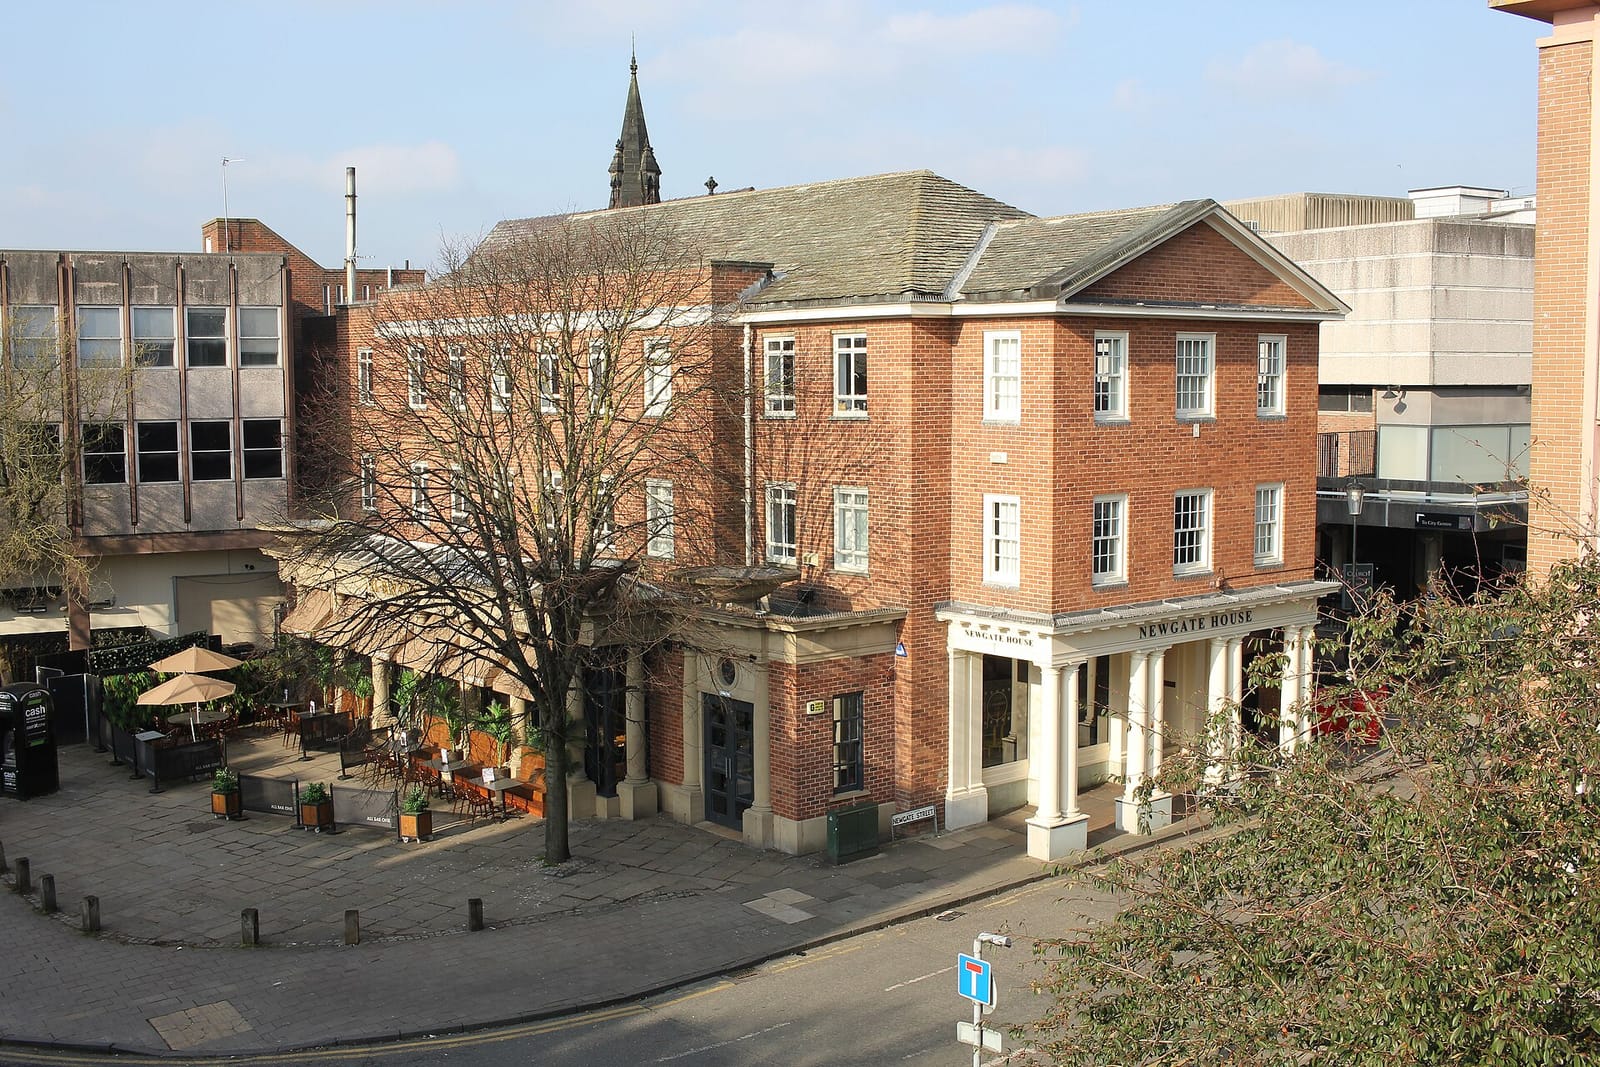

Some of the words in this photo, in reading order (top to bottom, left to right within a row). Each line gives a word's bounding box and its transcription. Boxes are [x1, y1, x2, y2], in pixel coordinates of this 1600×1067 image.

[1138, 616, 1206, 640] NEWGATE
[1211, 610, 1253, 629] HOUSE
[964, 629, 1004, 643] NEWGATE
[1006, 635, 1034, 647] HOUSE
[25, 704, 46, 717] cash
[892, 814, 914, 825] NEWGATE
[916, 808, 933, 819] STREET
